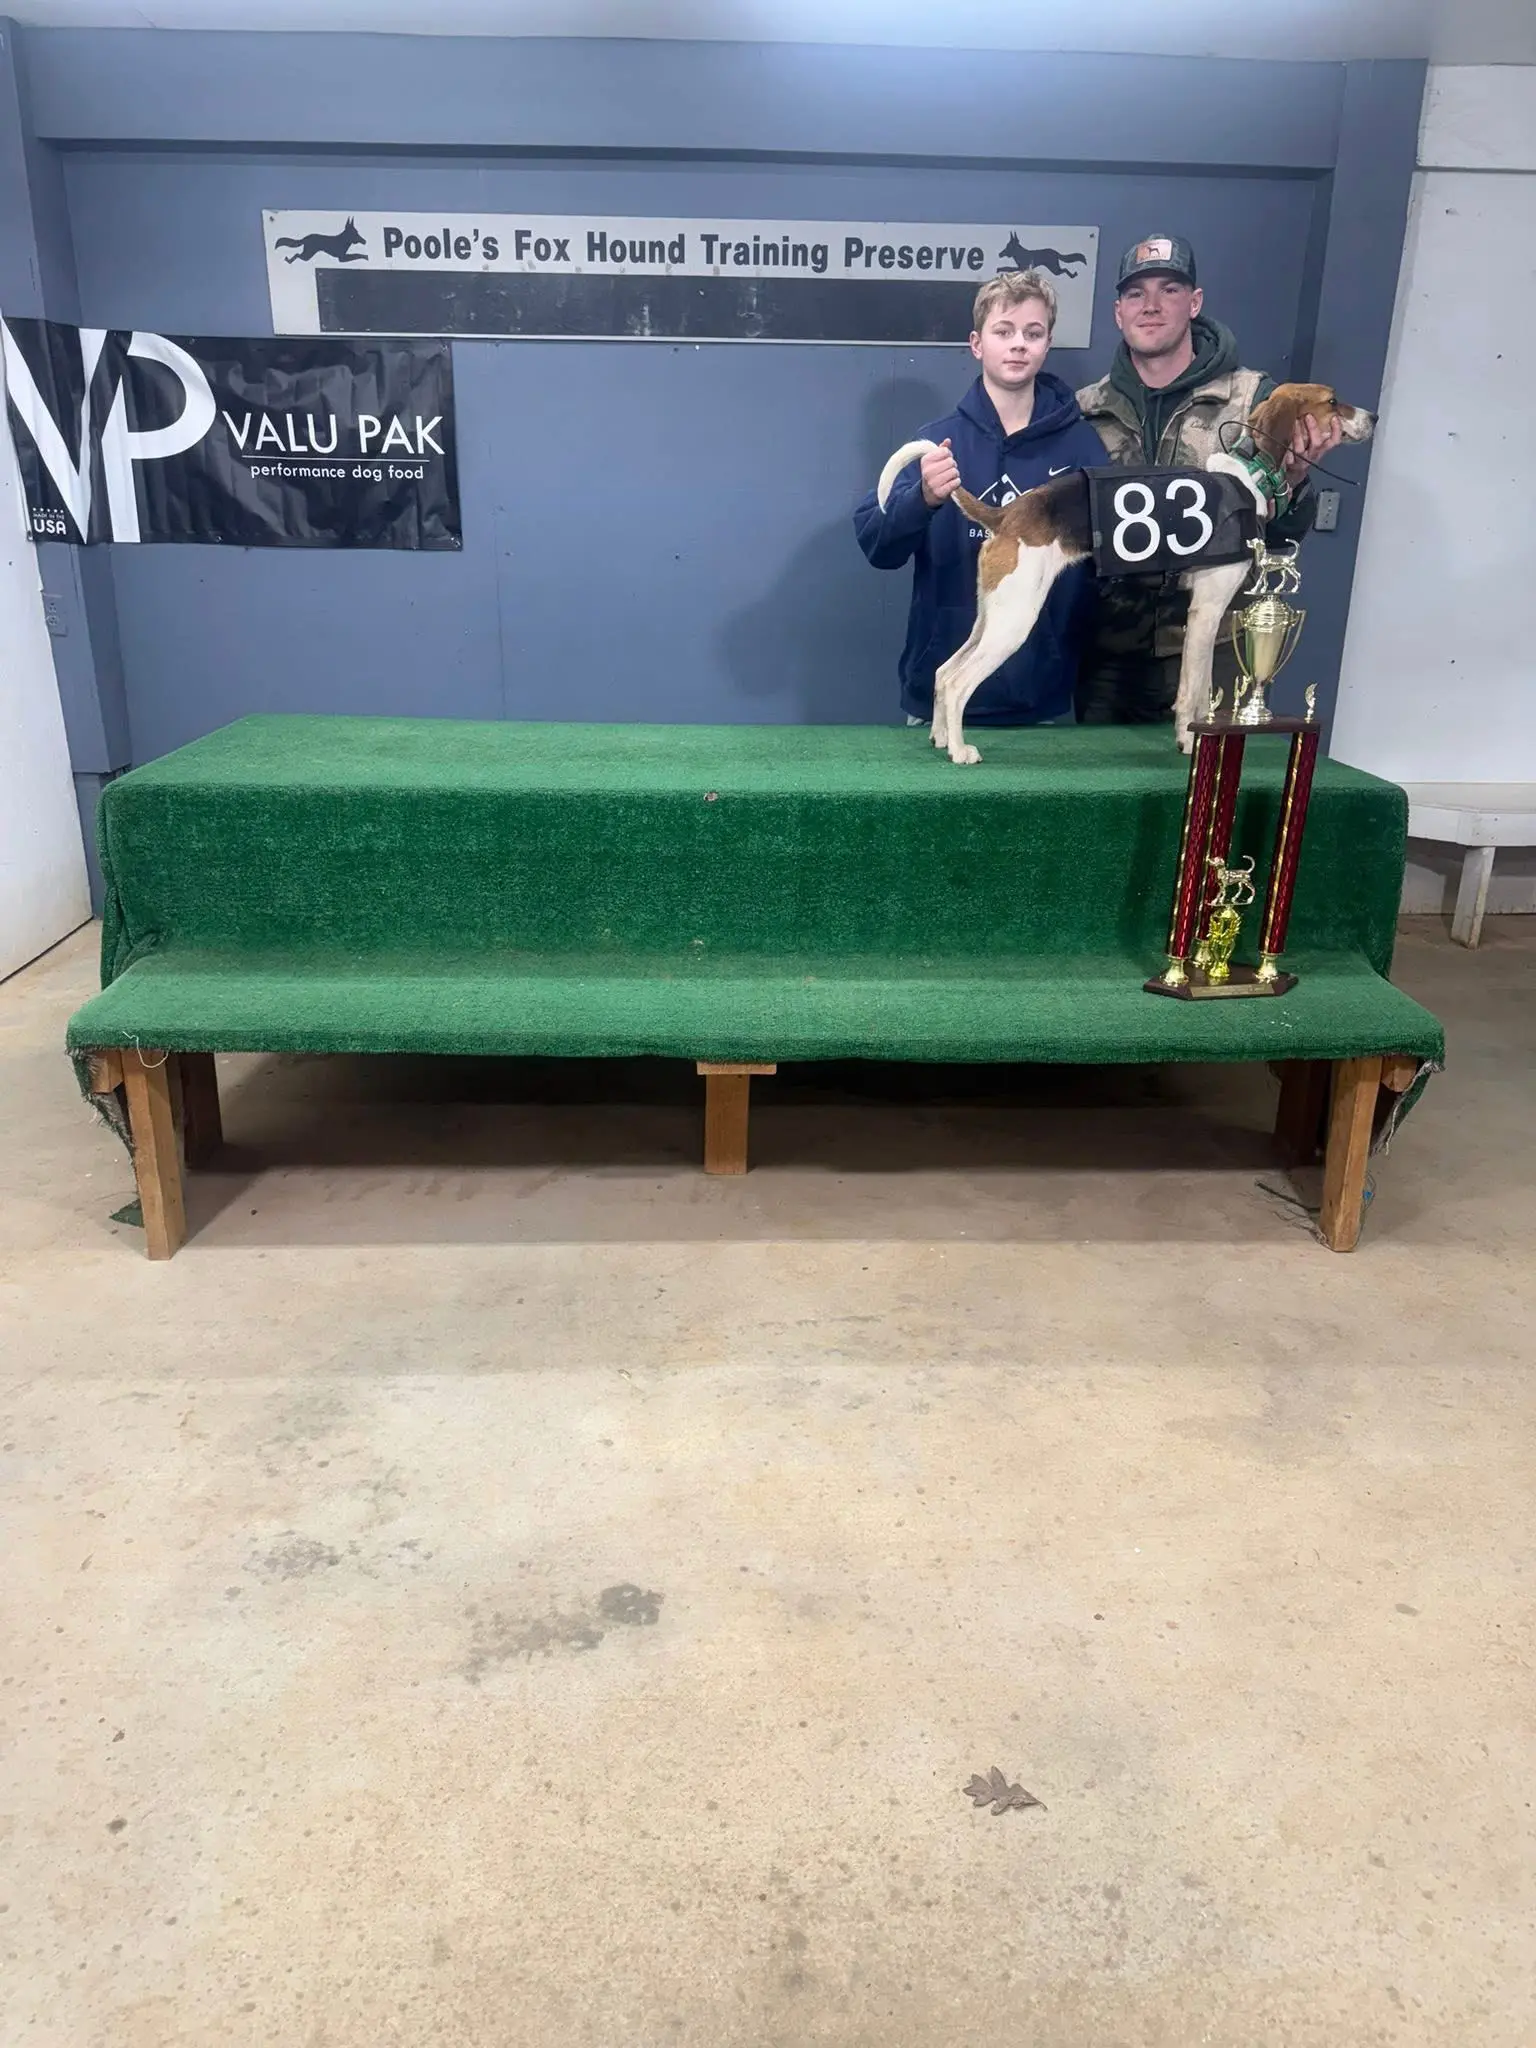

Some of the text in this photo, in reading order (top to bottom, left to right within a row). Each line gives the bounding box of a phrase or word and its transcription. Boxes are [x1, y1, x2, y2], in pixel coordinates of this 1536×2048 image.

[383, 226, 984, 274] Poole's Fox Hound Training Preserve
[222, 410, 446, 455] VALU PAK
[250, 462, 424, 482] performance dog food
[33, 519, 67, 535] USA
[1112, 478, 1214, 562] 83
